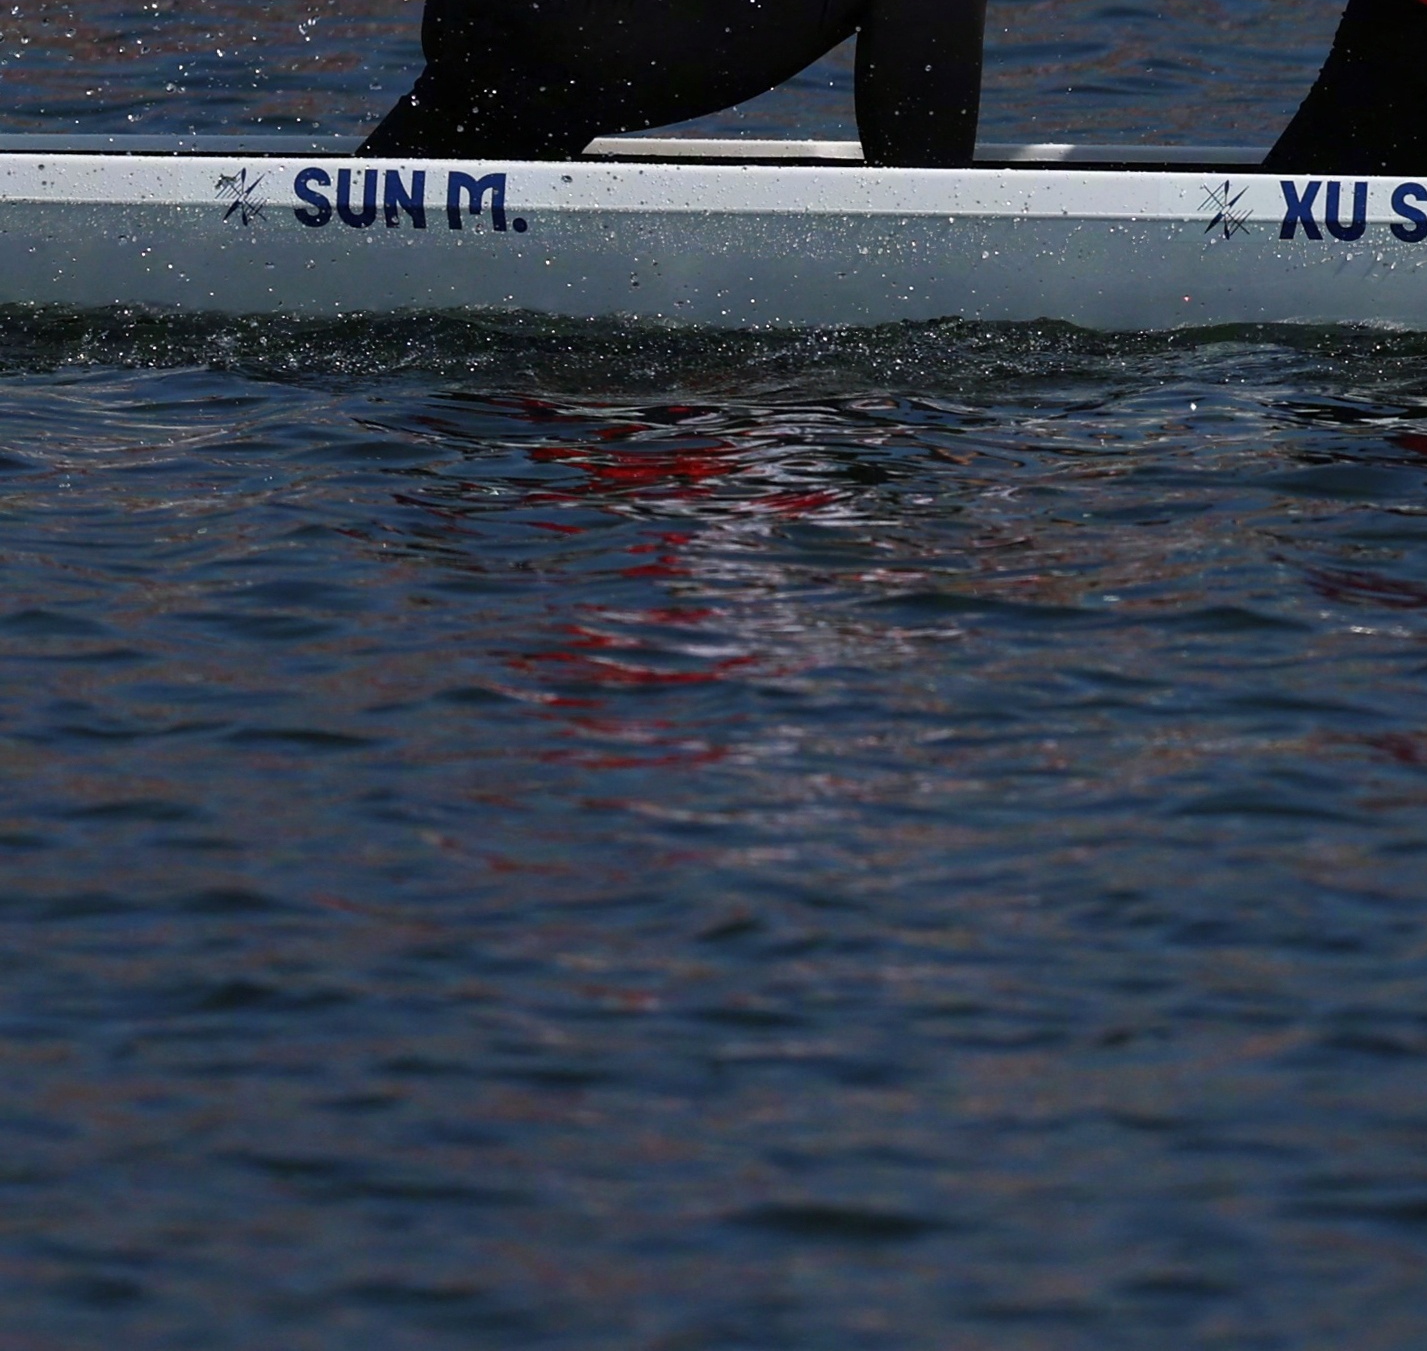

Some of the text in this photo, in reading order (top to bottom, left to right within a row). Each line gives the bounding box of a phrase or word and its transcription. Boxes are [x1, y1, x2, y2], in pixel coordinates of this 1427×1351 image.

[293, 166, 529, 233] SUN M.
[1278, 180, 1369, 242] XU
